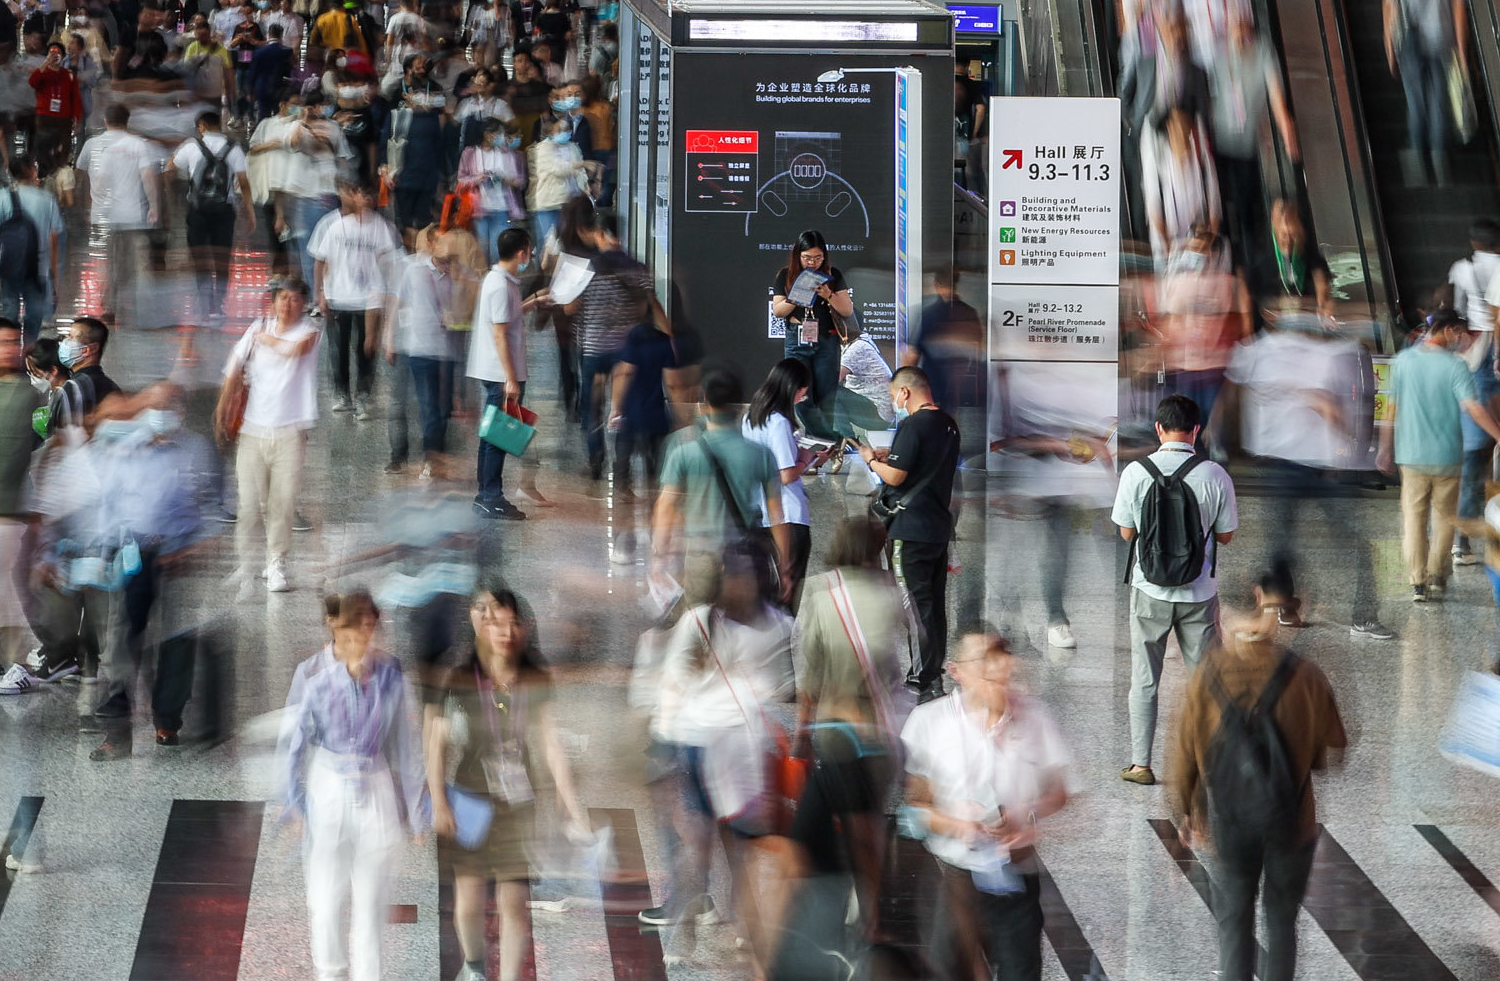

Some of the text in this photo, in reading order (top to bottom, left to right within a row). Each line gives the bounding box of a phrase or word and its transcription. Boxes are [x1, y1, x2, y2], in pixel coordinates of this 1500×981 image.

[756, 82, 871, 94] 为企业塑造全球化品牌
[755, 95, 781, 104] Building
[782, 95, 801, 104] global
[801, 95, 824, 103] brands
[834, 96, 871, 104] enterprises
[1034, 145, 1067, 159] Hall
[1072, 145, 1105, 159] 展厅
[1028, 163, 1111, 182] 9.3-11.3
[1022, 196, 1057, 205] Building
[1022, 205, 1112, 213] Decorative Materials
[1022, 213, 1081, 222] 建筑及装饰材料
[1021, 227, 1111, 236] New Energy Resources
[1022, 235, 1047, 244] 新能源
[1021, 249, 1107, 259] Lighting Equipment
[1021, 258, 1055, 267] 照明产品
[1042, 303, 1083, 313] 9.2-13.2
[1002, 310, 1023, 327] 2F
[1028, 318, 1046, 326] Pearl
[1047, 318, 1065, 326] River
